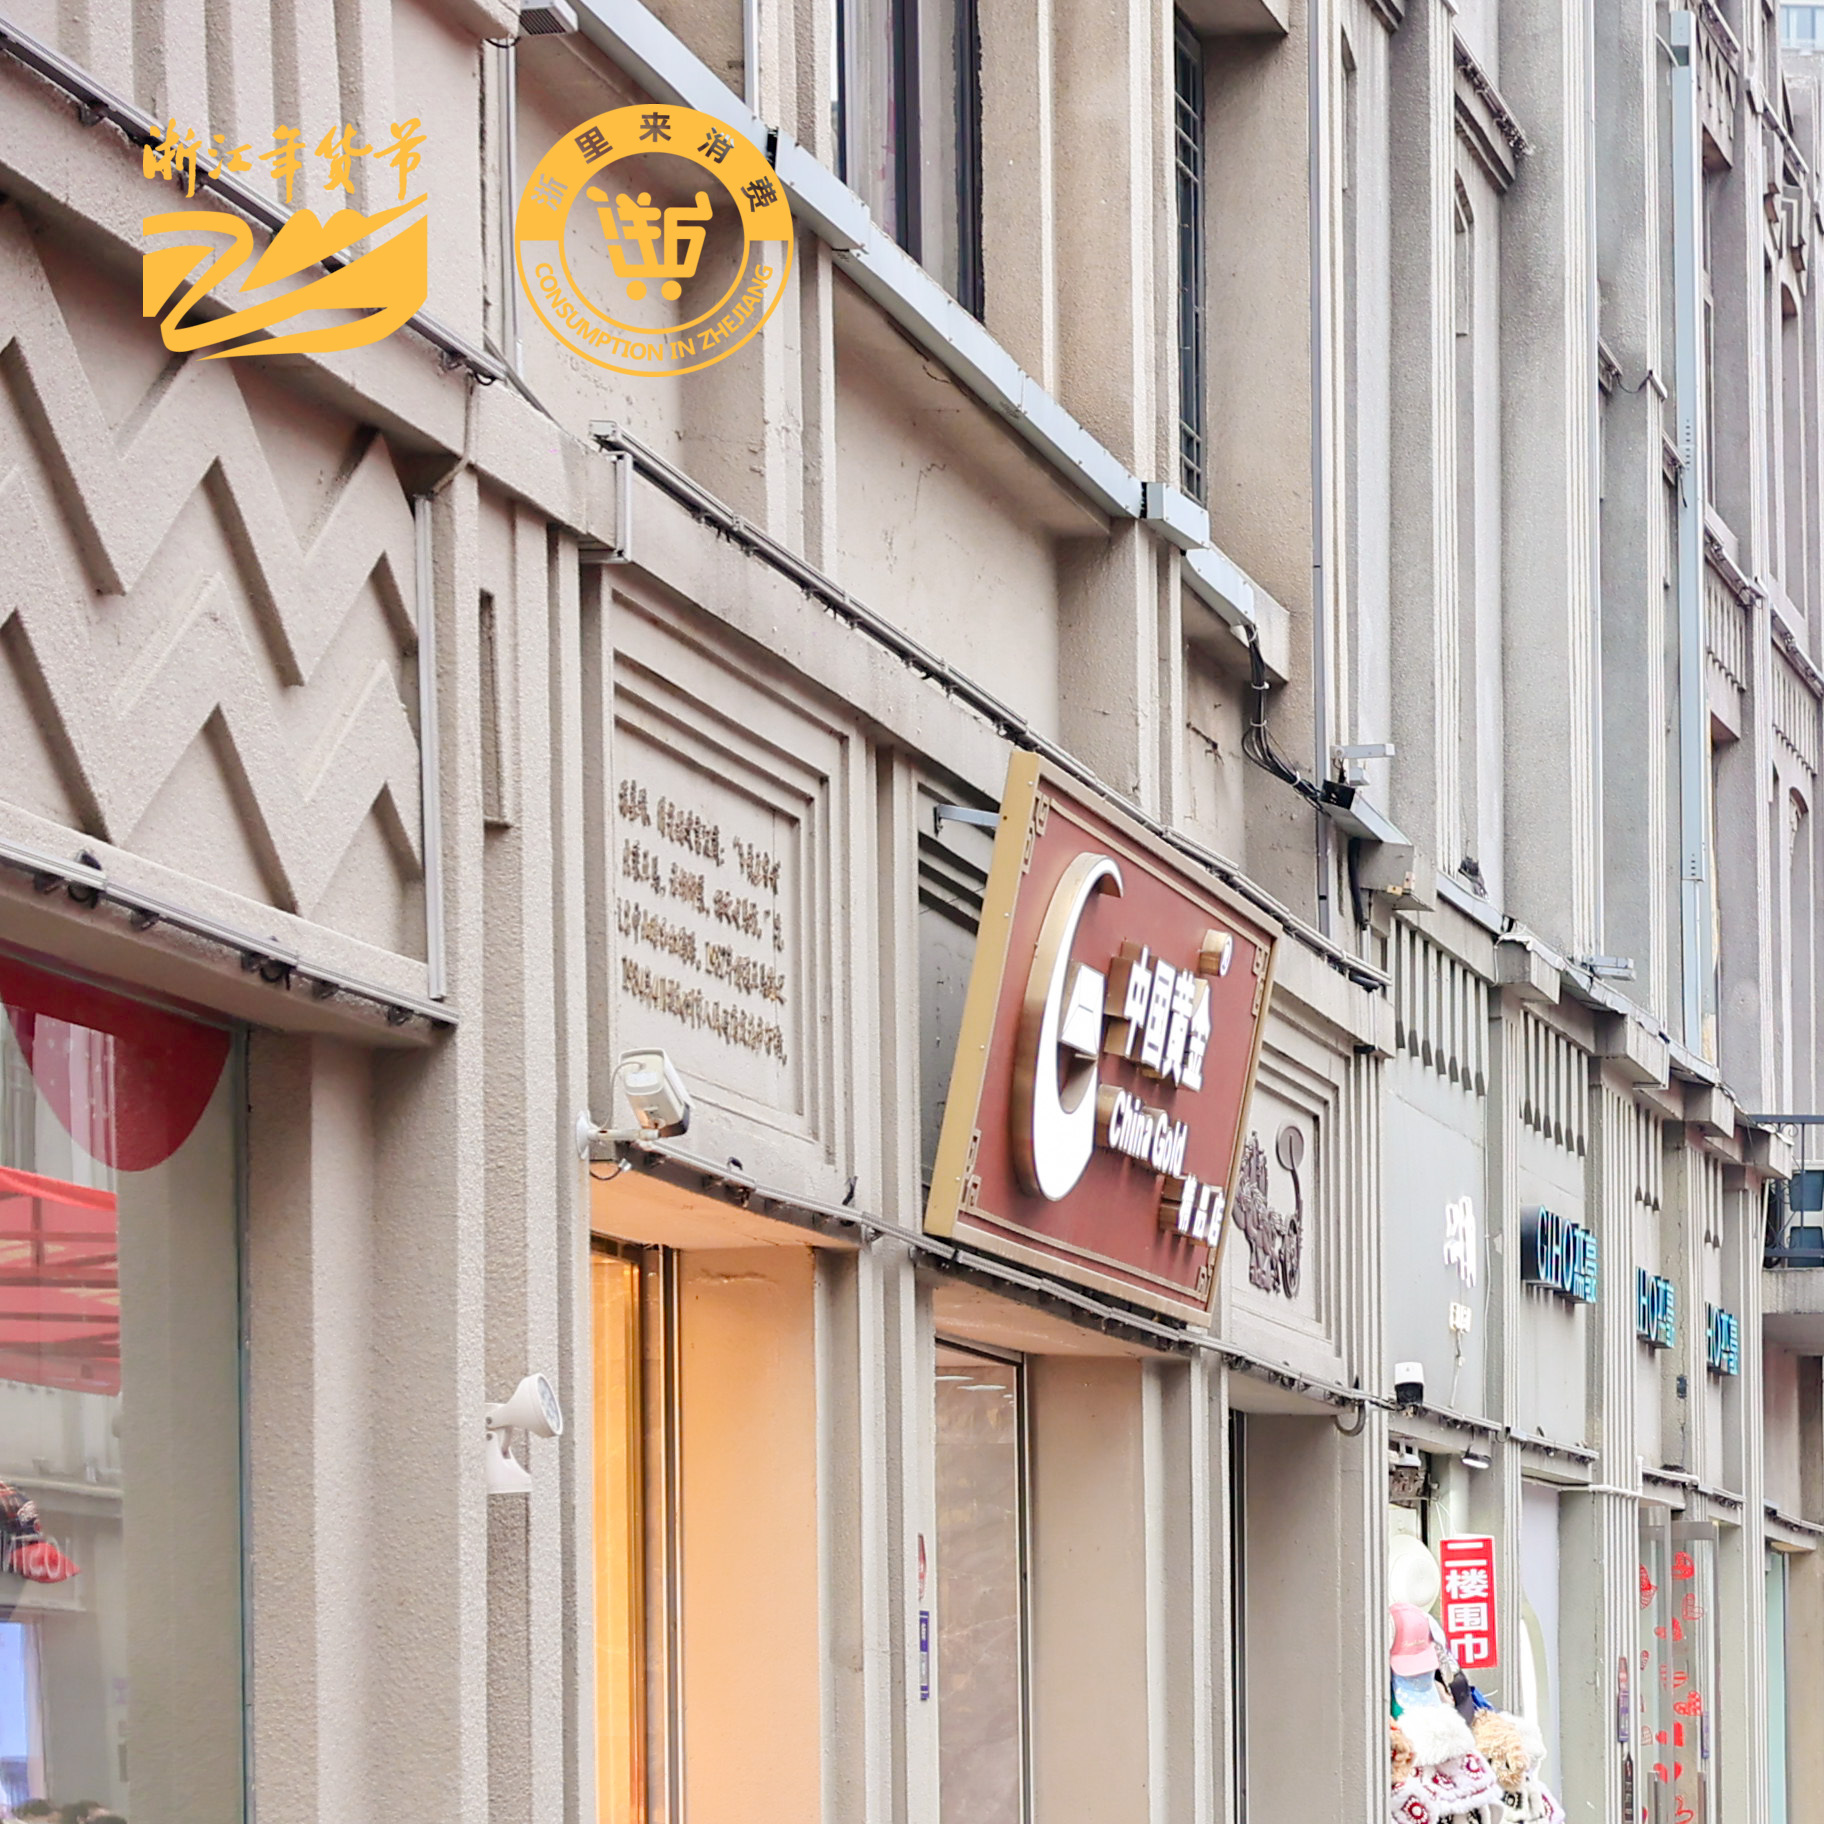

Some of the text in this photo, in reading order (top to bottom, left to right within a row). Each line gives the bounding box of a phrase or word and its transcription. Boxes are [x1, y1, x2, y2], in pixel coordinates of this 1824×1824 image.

[1124, 944, 1211, 1092] 中国黄金
[1109, 1090, 1188, 1178] China Gold
[1444, 1540, 1490, 1664] 二楼围巾
